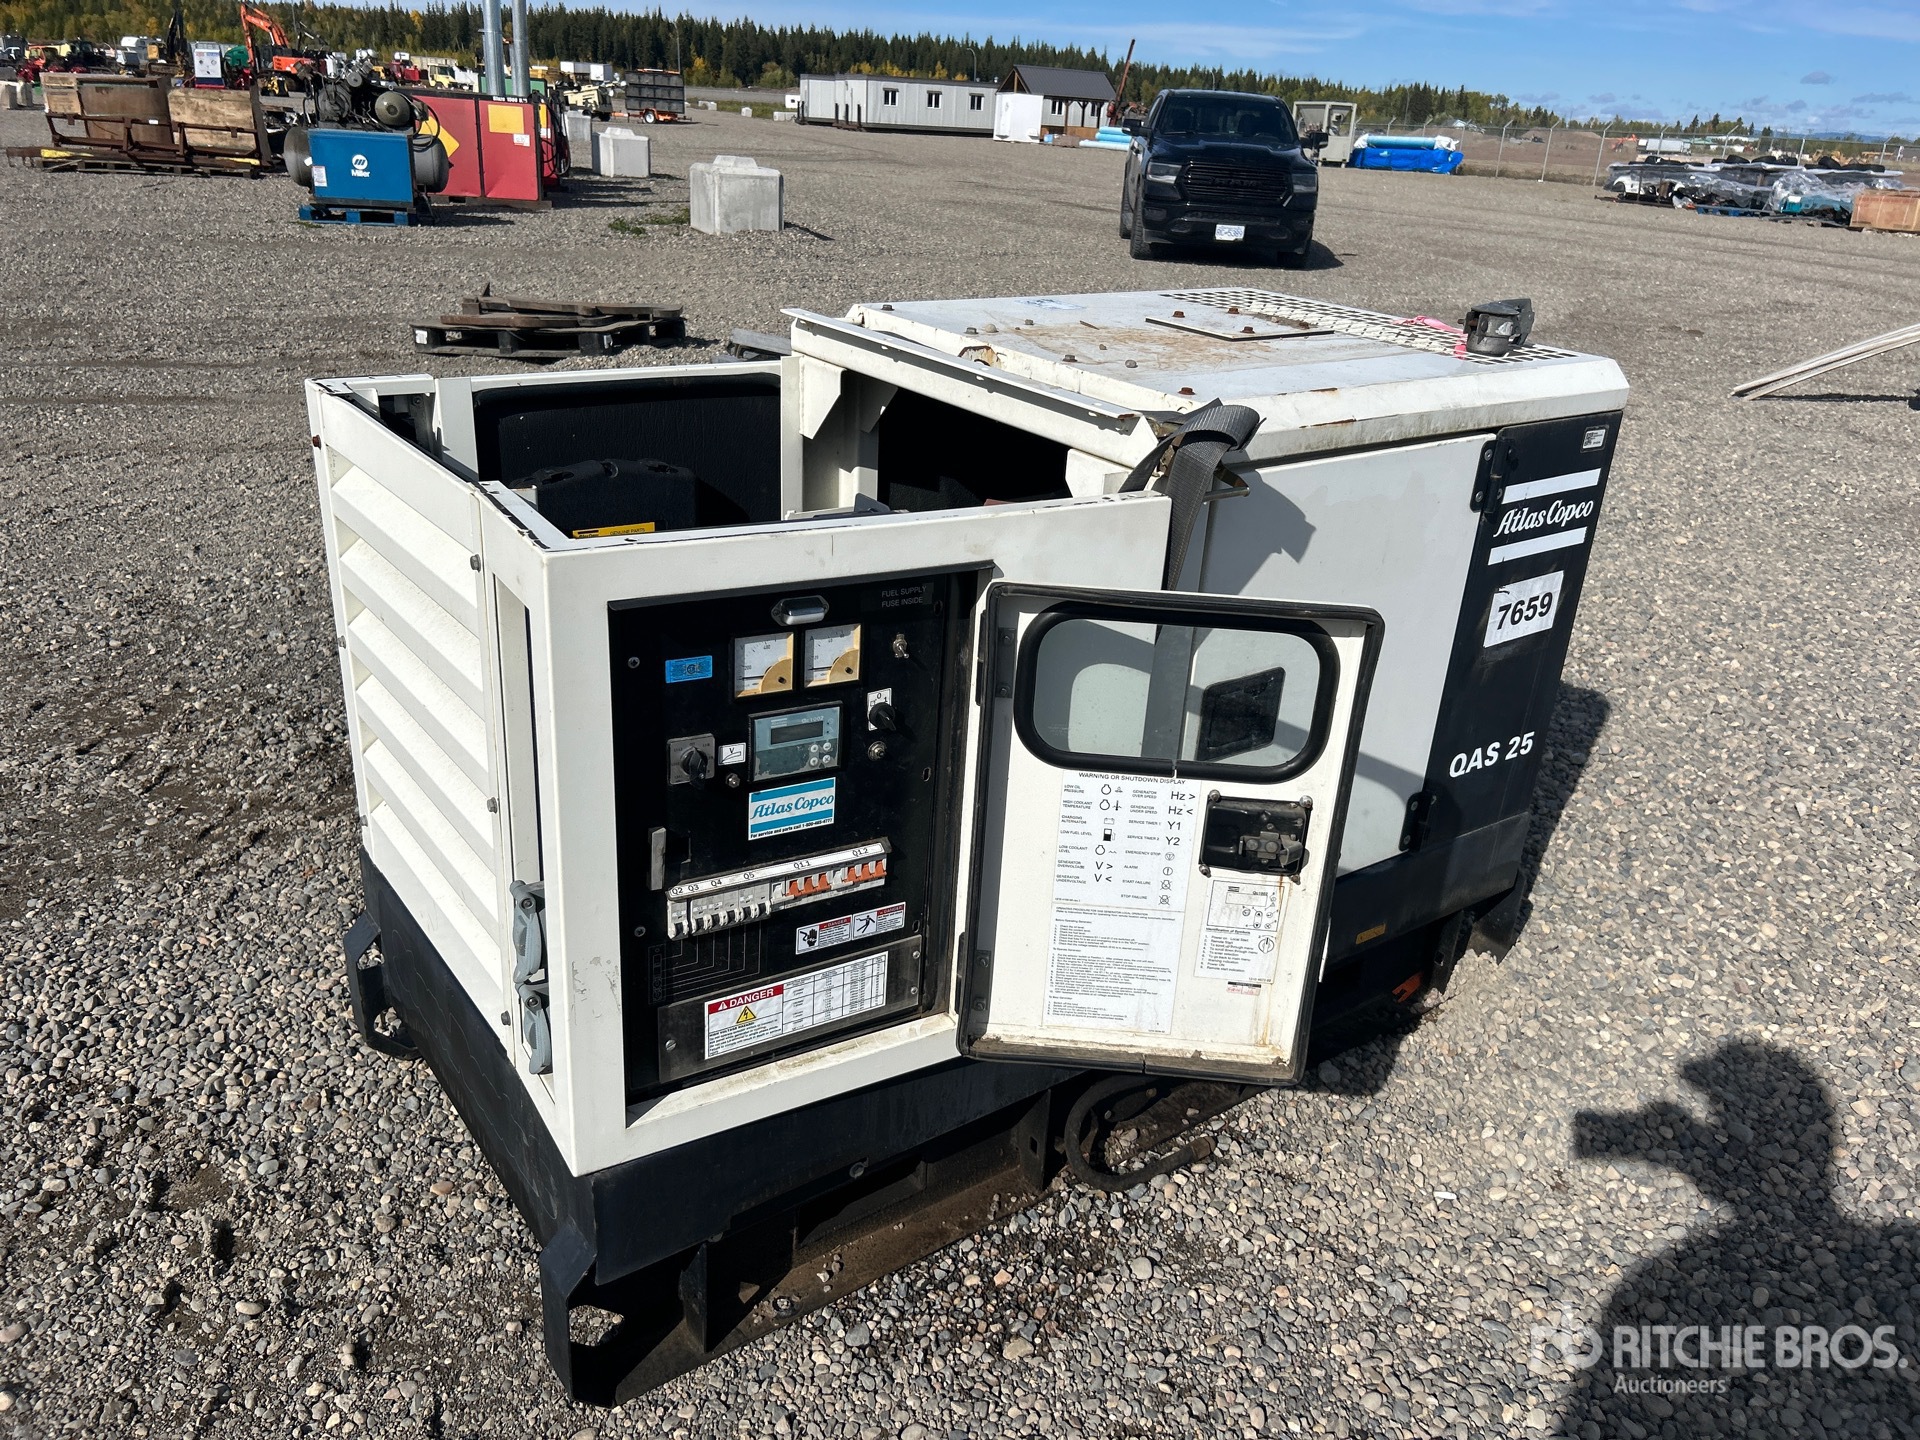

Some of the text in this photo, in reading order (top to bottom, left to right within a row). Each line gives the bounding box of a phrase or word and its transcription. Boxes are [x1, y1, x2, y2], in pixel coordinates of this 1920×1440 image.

[351, 169, 370, 177] Miller
[1492, 500, 1594, 538] Atlas Copco
[882, 586, 926, 598] FUEL SUPPLY
[882, 596, 923, 608] FUSE INSIDE
[1497, 592, 1553, 630] 7659
[1449, 731, 1535, 778] QAS 25
[1079, 772, 1109, 780] WARNING
[1171, 791, 1186, 800] Hz
[750, 794, 834, 819] Atlas Copco
[1168, 806, 1183, 815] Hz
[1167, 821, 1181, 830] Y1
[1166, 836, 1180, 846] Y2
[852, 848, 868, 857] Q1.2
[793, 860, 811, 870] Q1.1
[1095, 861, 1104, 870] V
[1094, 874, 1102, 882] V
[710, 879, 722, 887] Q4
[672, 887, 683, 895] Q2
[828, 919, 848, 927] DANGER
[729, 988, 774, 1008] DANGER
